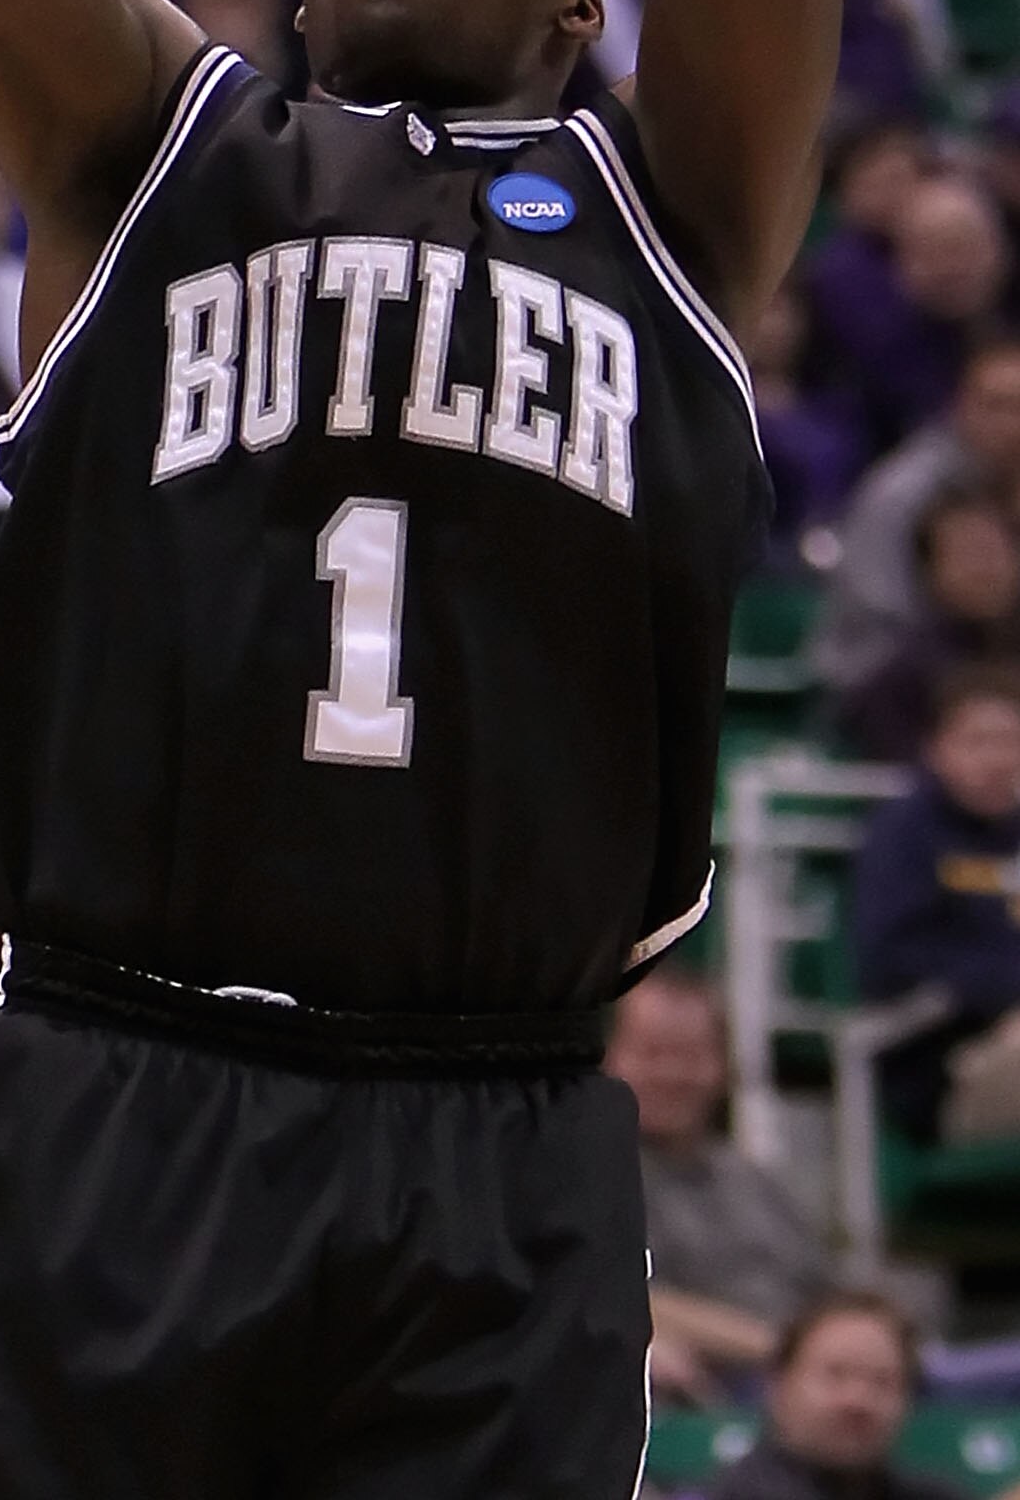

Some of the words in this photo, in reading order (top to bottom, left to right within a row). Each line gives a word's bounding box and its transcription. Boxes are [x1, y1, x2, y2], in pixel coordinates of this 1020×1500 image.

[502, 200, 567, 219] NCAA
[150, 236, 639, 519] BUTLER
[302, 496, 414, 768] 1
